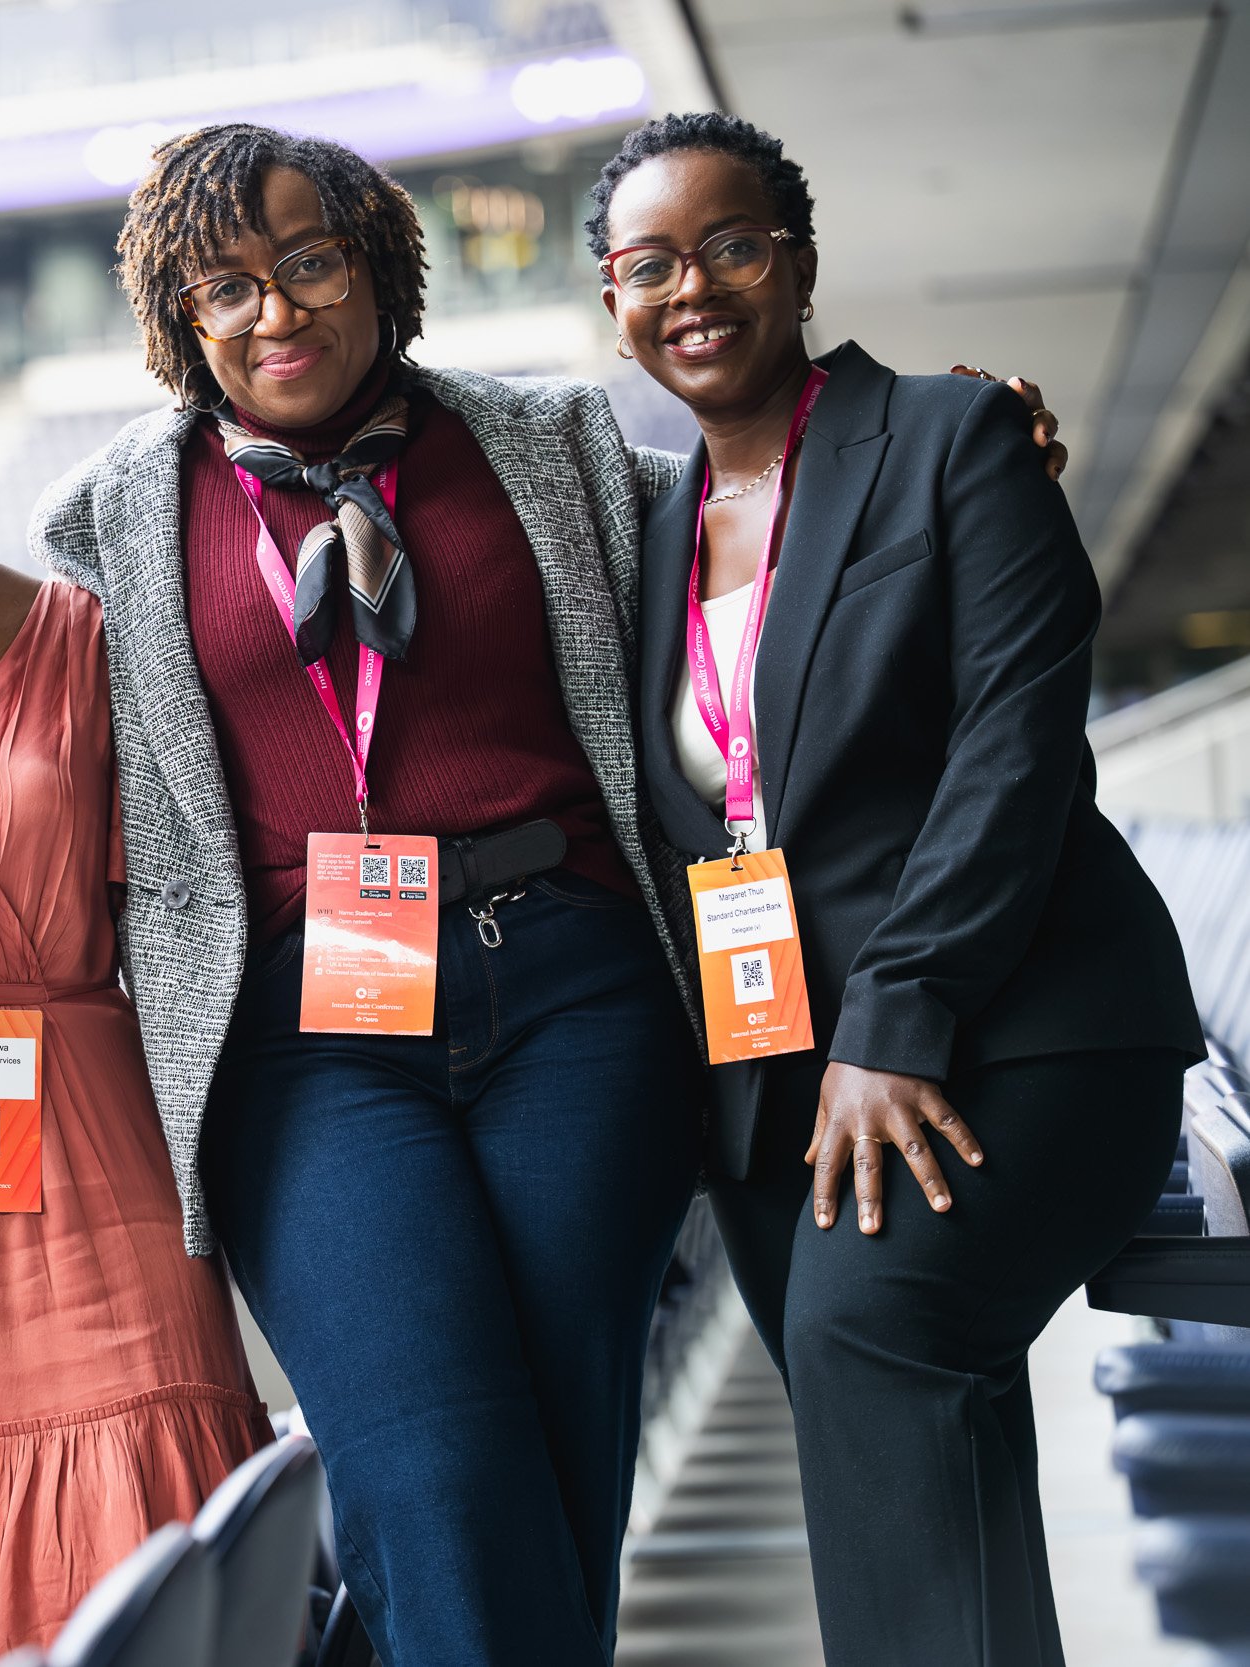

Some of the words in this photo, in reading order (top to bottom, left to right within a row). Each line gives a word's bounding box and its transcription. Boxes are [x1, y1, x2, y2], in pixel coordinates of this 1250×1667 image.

[749, 585, 761, 625] Internal
[694, 622, 706, 670] Conference
[697, 669, 709, 692] Audit
[735, 653, 749, 712] Conference
[701, 691, 722, 732] Internal
[718, 890, 747, 901] Margaret
[748, 887, 764, 896] Thuo
[707, 911, 733, 922] Standard
[734, 905, 765, 917] Chartered
[766, 902, 782, 911] Bank
[731, 925, 753, 934] Delegate
[371, 1003, 404, 1011] Conference
